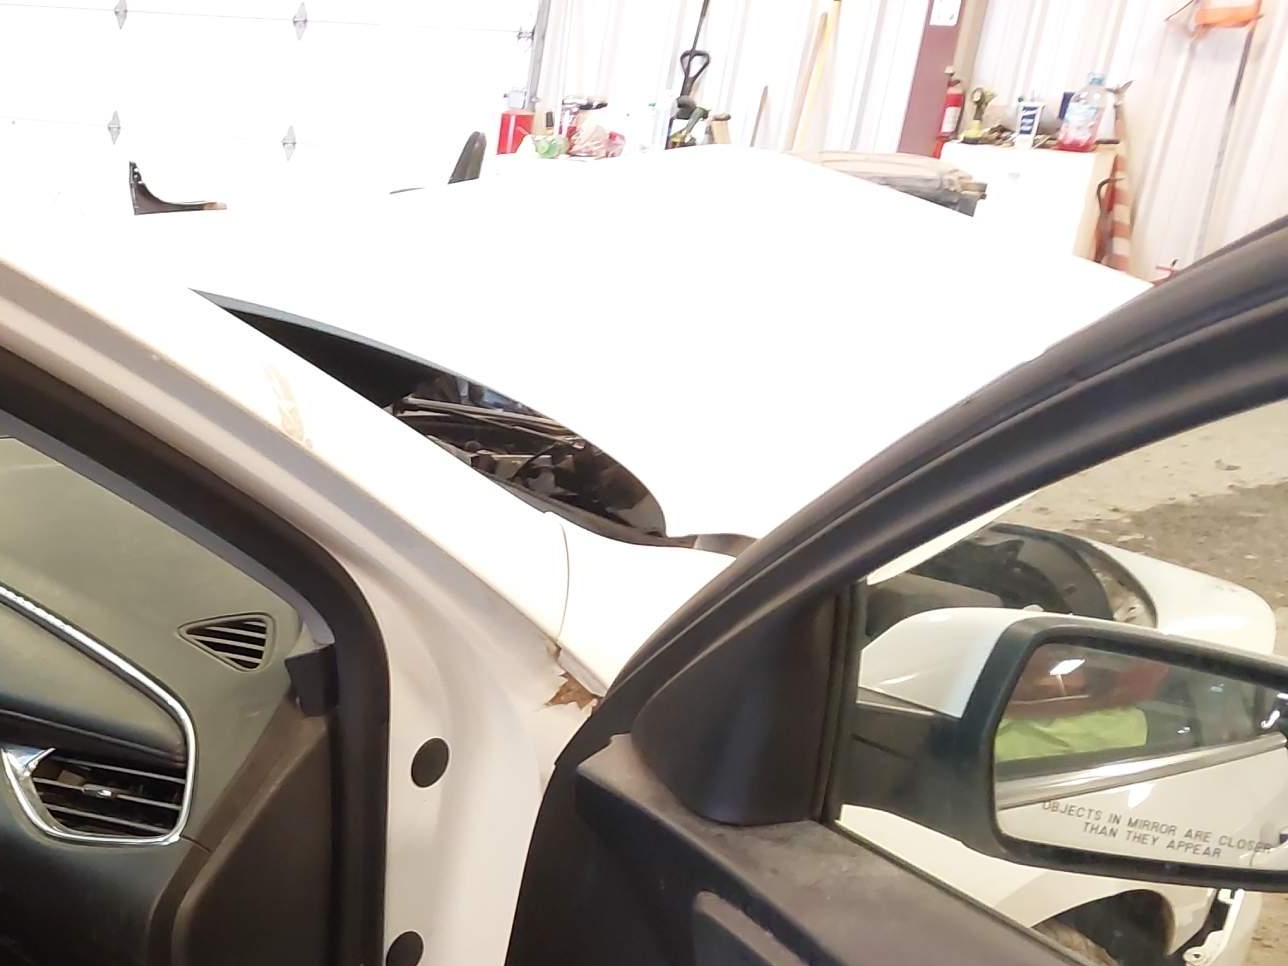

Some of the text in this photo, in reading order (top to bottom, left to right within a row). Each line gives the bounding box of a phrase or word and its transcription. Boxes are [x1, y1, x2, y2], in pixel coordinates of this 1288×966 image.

[1041, 800, 1272, 854] OBJECTS IN MIRROR ARE CLOSER
[1082, 821, 1223, 858] THAN THEY APPEAR
